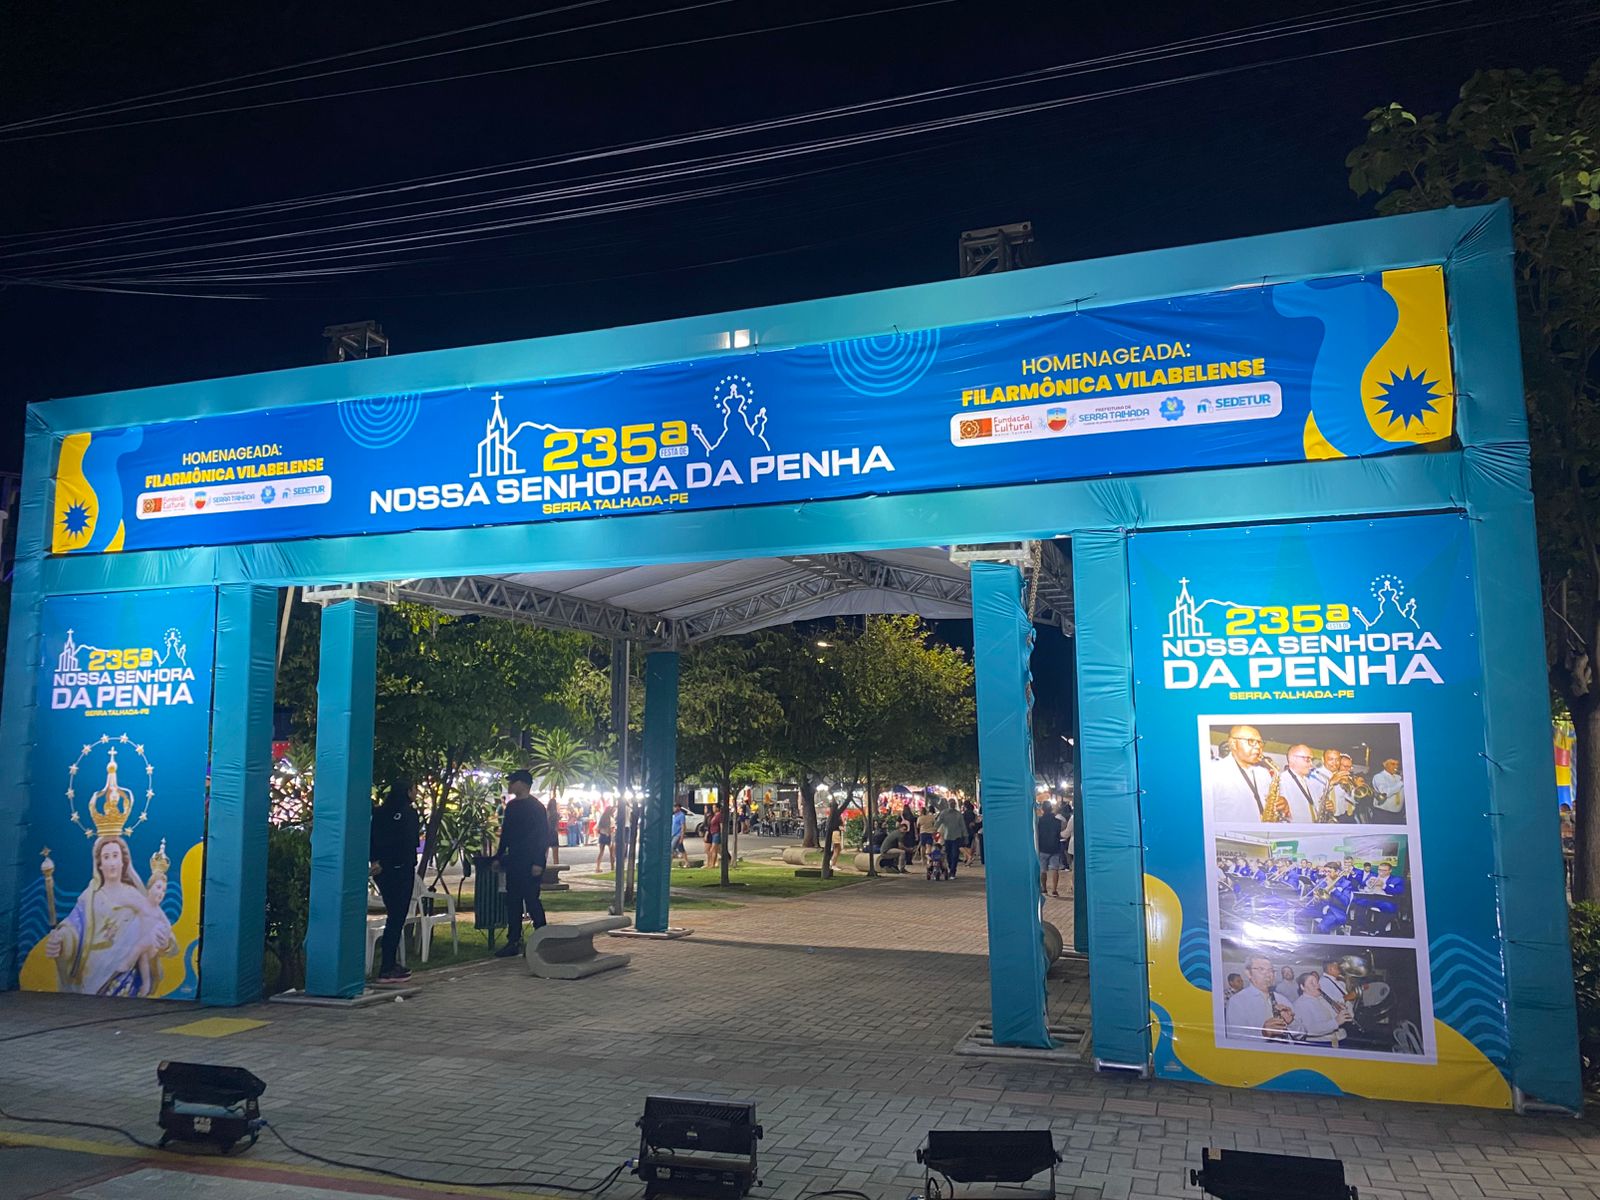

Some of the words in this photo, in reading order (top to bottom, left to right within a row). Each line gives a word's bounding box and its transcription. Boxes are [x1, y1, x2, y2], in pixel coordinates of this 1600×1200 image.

[1022, 341, 1192, 376] HOMENAGEADA:
[961, 375, 1112, 407] FILARMÔNICA
[1115, 358, 1266, 389] VILABELENSE
[1215, 393, 1271, 408] SEDETUR
[993, 421, 1033, 433] Cultural
[1078, 413, 1109, 422] SERRA
[182, 443, 283, 465] HOMENAGEADA:
[145, 467, 235, 488] FILARMÔNICA
[236, 458, 324, 479] VILABELENSE
[369, 482, 490, 514] NOSSA
[496, 465, 676, 504] SENHORA
[686, 457, 746, 490] DA
[750, 445, 895, 484] PENHA
[542, 502, 591, 514] SERRA
[594, 493, 689, 512] TALHADA-PE
[1162, 637, 1273, 657] NOSSA
[1277, 632, 1442, 655] SENHORA
[53, 671, 112, 686] NOSSA
[114, 667, 195, 684] SENHORA
[1163, 658, 1241, 690] DA
[1249, 653, 1445, 689] PENHA
[51, 687, 92, 710] DA
[96, 682, 194, 708] PENHA
[1229, 691, 1272, 700] SERRA
[1273, 690, 1355, 699] TALHADA-PE
